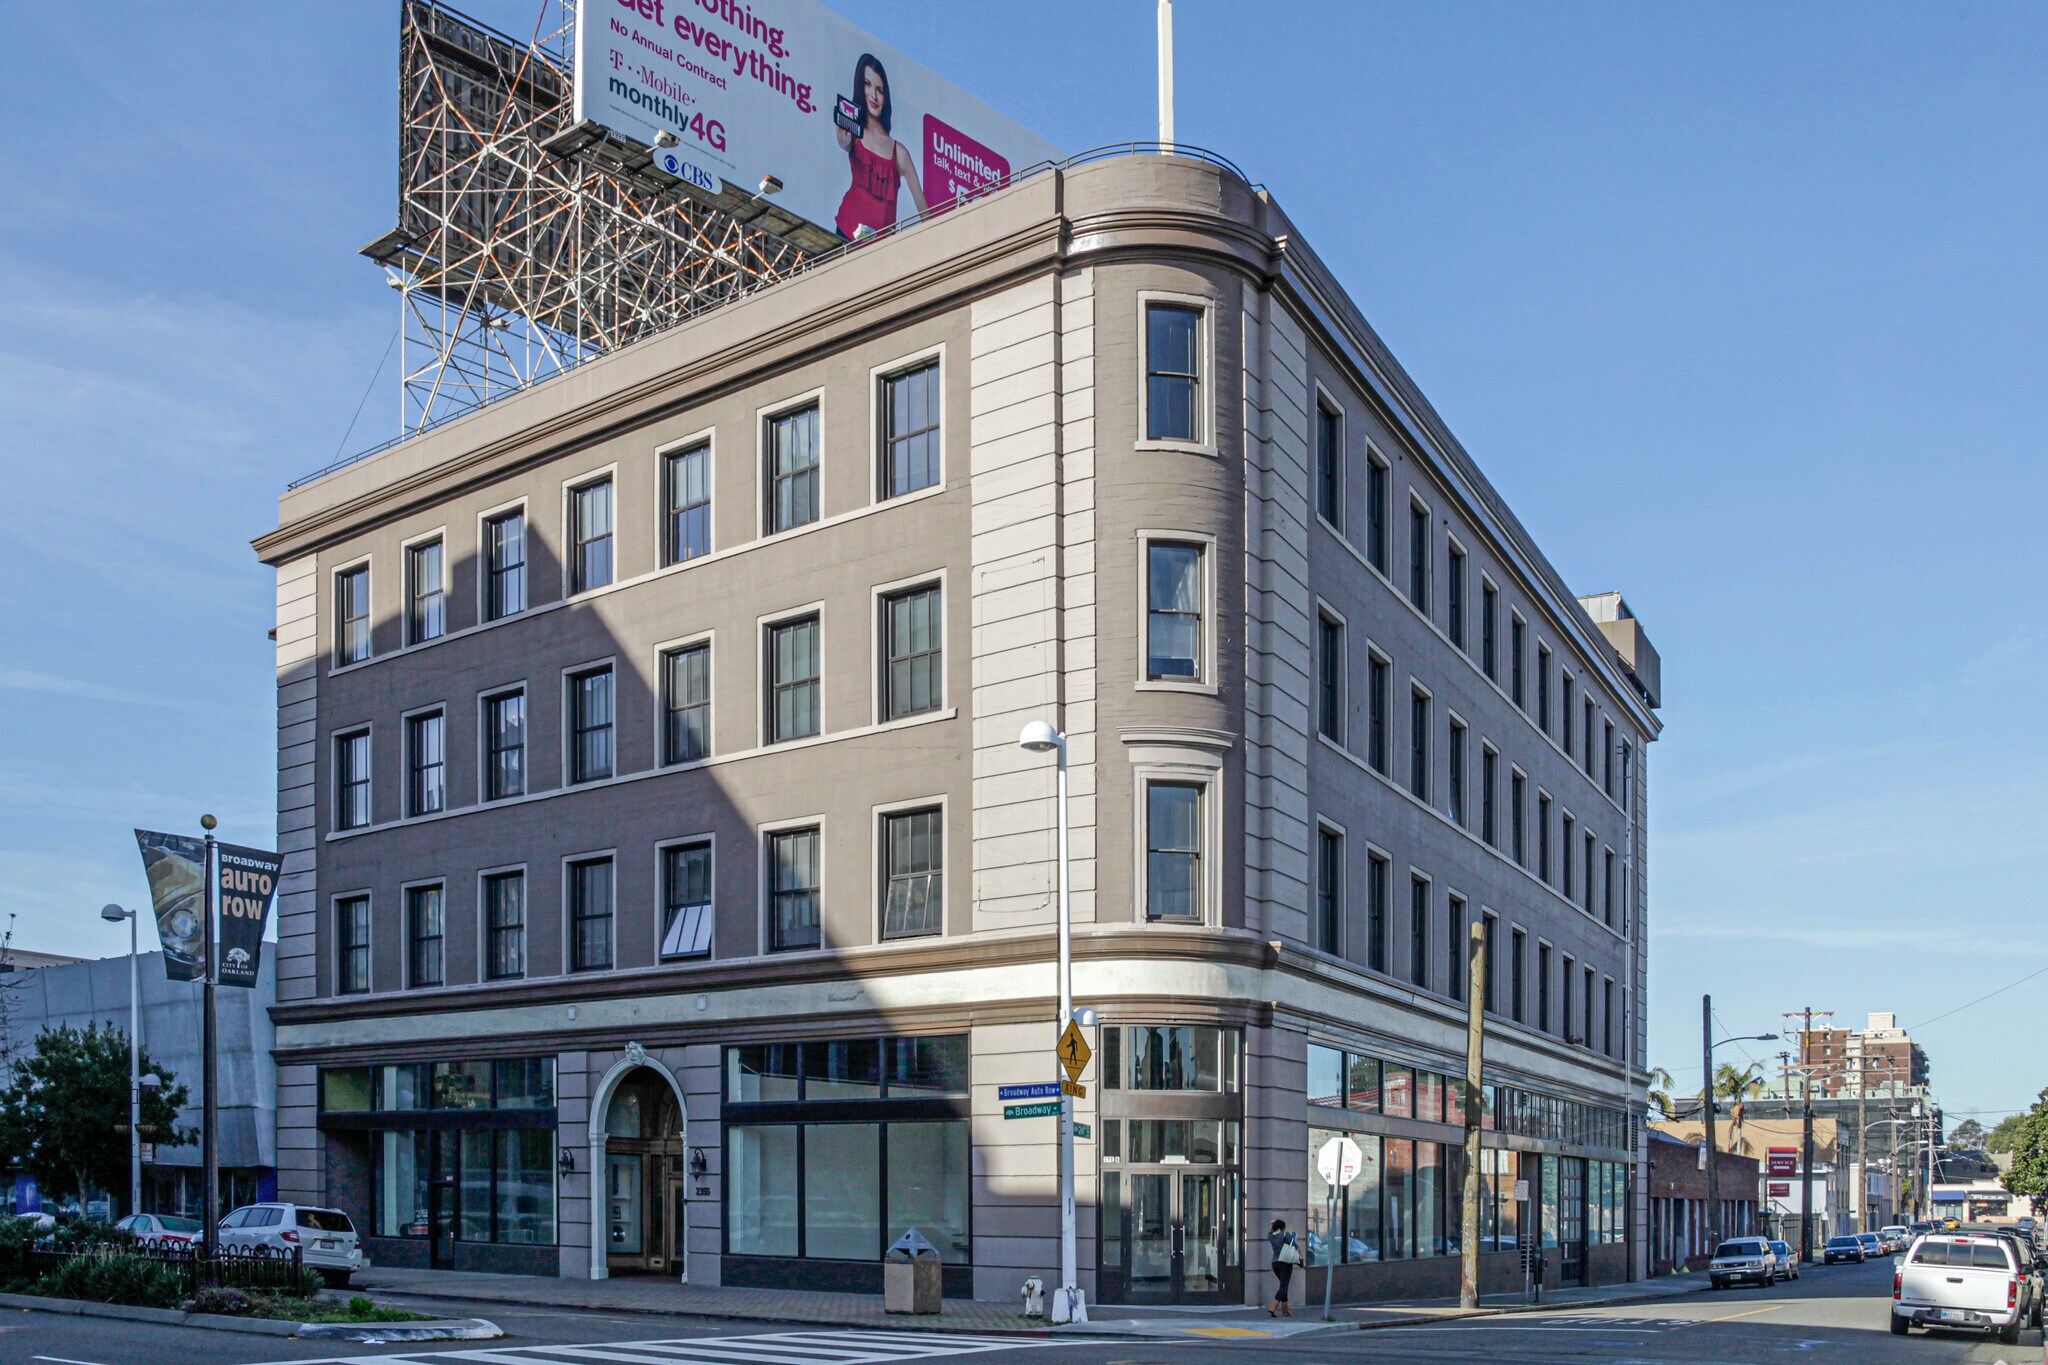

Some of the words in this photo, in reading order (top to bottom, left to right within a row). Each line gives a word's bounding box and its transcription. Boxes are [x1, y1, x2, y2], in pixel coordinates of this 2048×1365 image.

[695, 0, 790, 58] othing.
[610, 17, 628, 36] No
[632, 30, 673, 61] Annual
[676, 54, 727, 90] Contract
[674, 15, 817, 114] everything.
[933, 132, 1001, 186] Unlimited
[681, 162, 713, 190] CBS
[954, 164, 971, 183] text
[973, 175, 980, 187] &
[221, 967, 255, 976] OAKLAND
[1003, 1088, 1029, 1097] Broadway
[1030, 1086, 1044, 1096] Auto
[1044, 1085, 1056, 1094] Row
[1065, 1083, 1083, 1096] XING
[1015, 1105, 1052, 1116] Broadway
